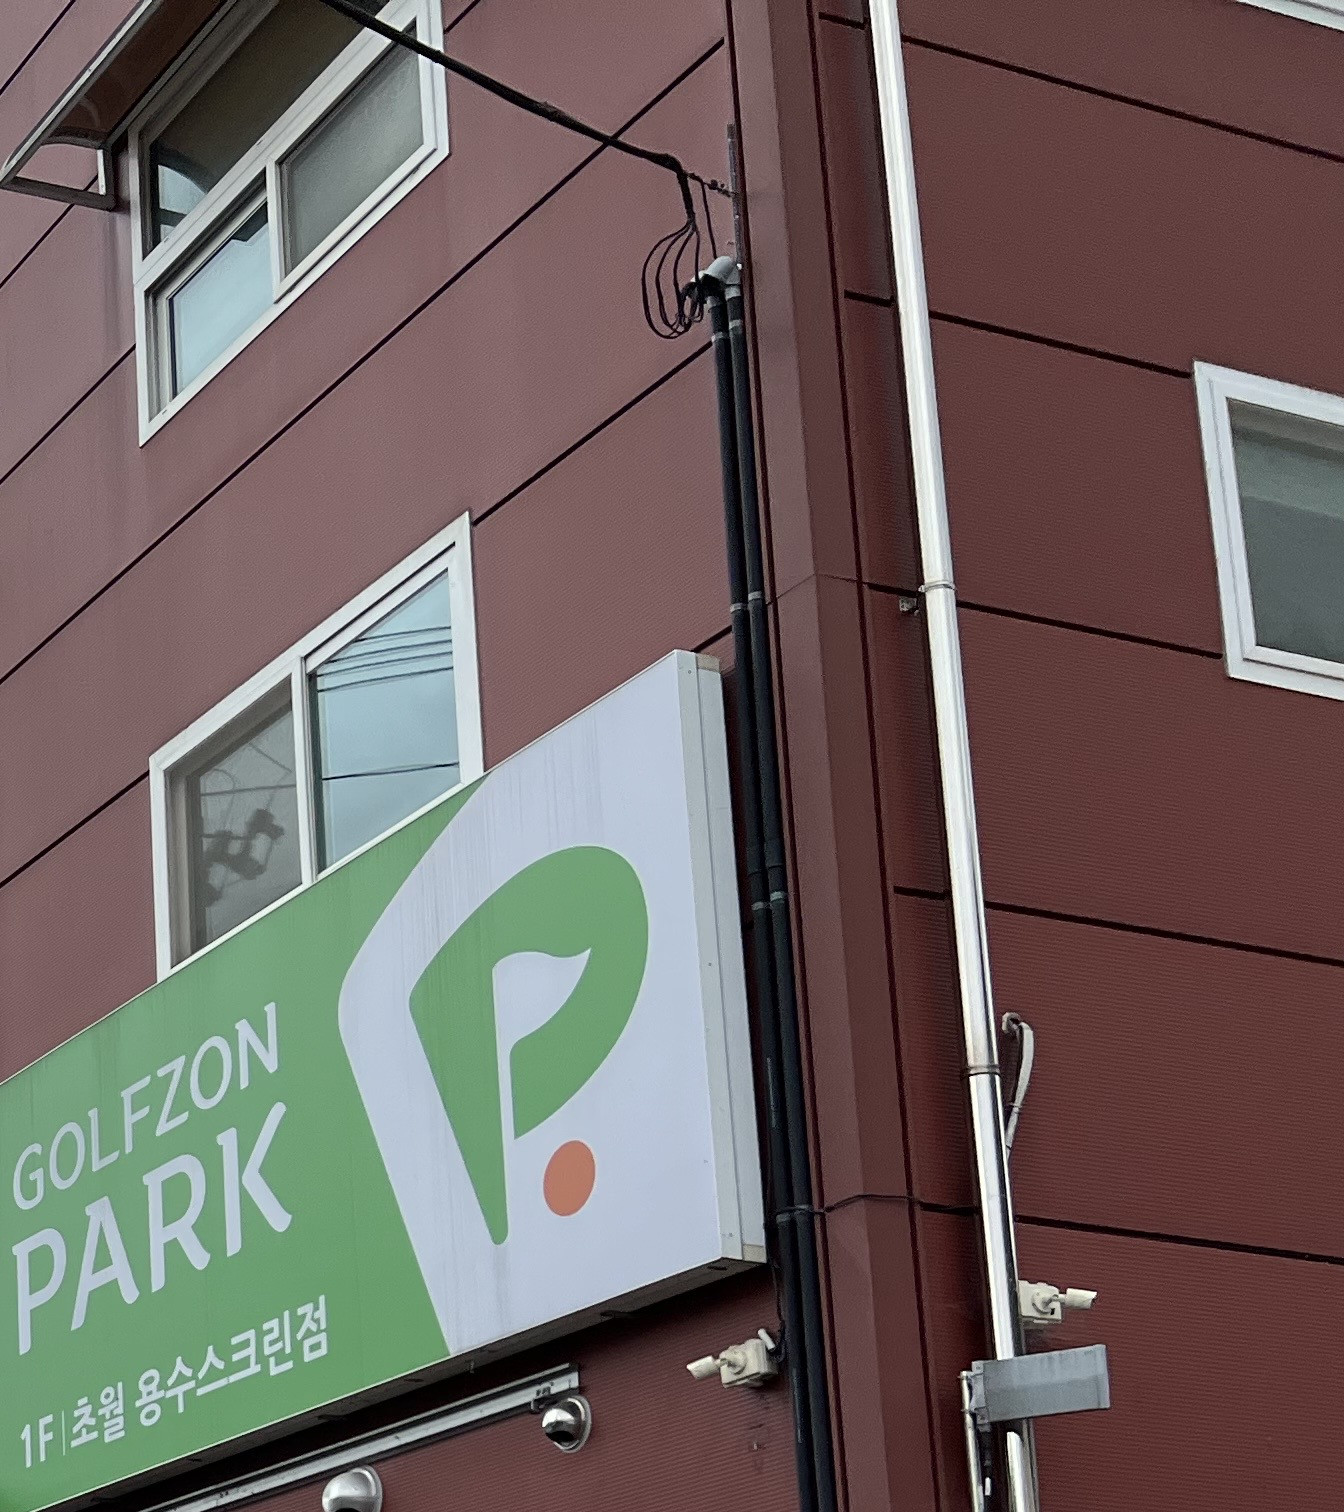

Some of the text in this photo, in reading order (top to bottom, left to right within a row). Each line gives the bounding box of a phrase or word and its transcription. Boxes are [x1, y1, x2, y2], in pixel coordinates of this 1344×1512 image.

[12, 1002, 280, 1210] GOLFZON
[10, 1100, 293, 1356] PARK
[20, 1294, 330, 1469] 1F 초월 용수스크린점
